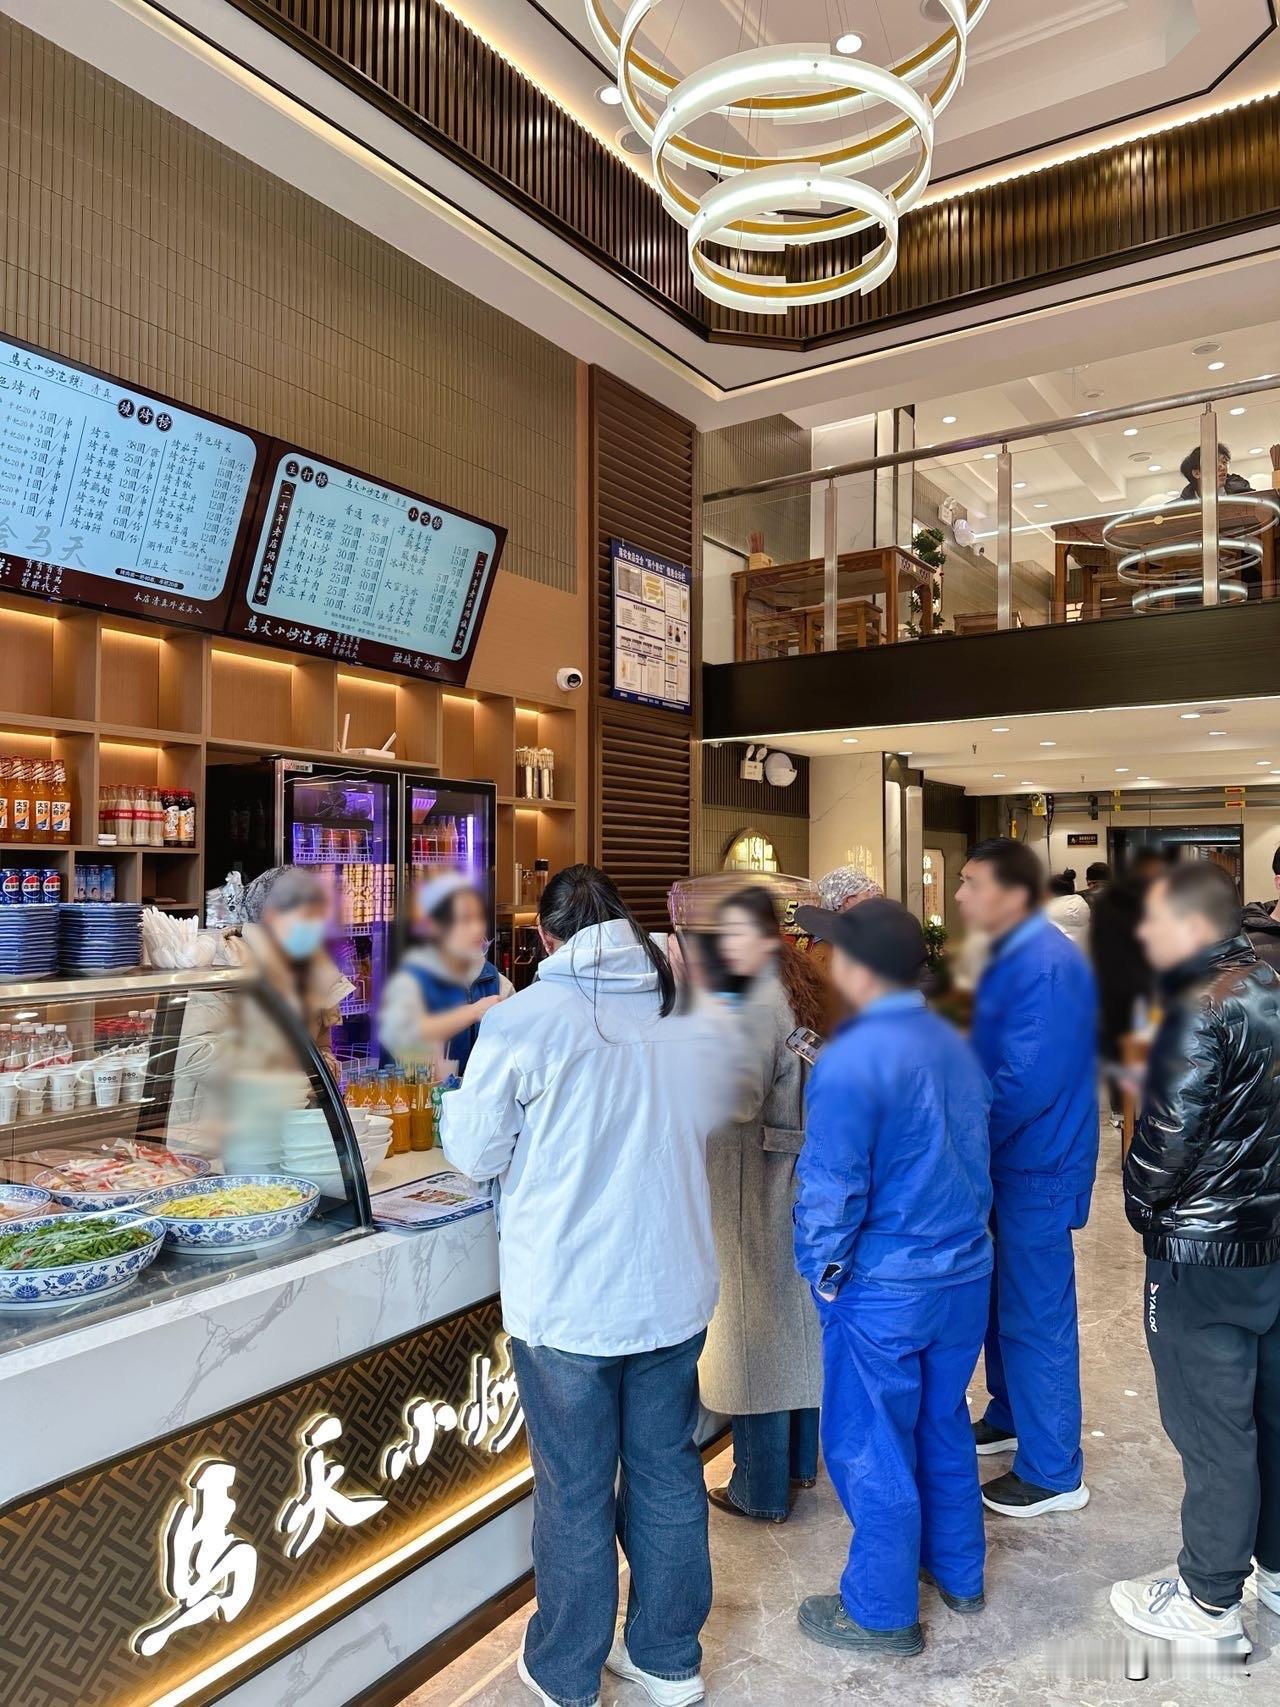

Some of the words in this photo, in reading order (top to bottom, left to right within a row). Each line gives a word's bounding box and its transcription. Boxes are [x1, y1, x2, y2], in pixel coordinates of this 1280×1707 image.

[287, 461, 328, 488] 主打榜
[408, 507, 443, 530] 小吃榜
[1149, 1295, 1158, 1333] YALOO
